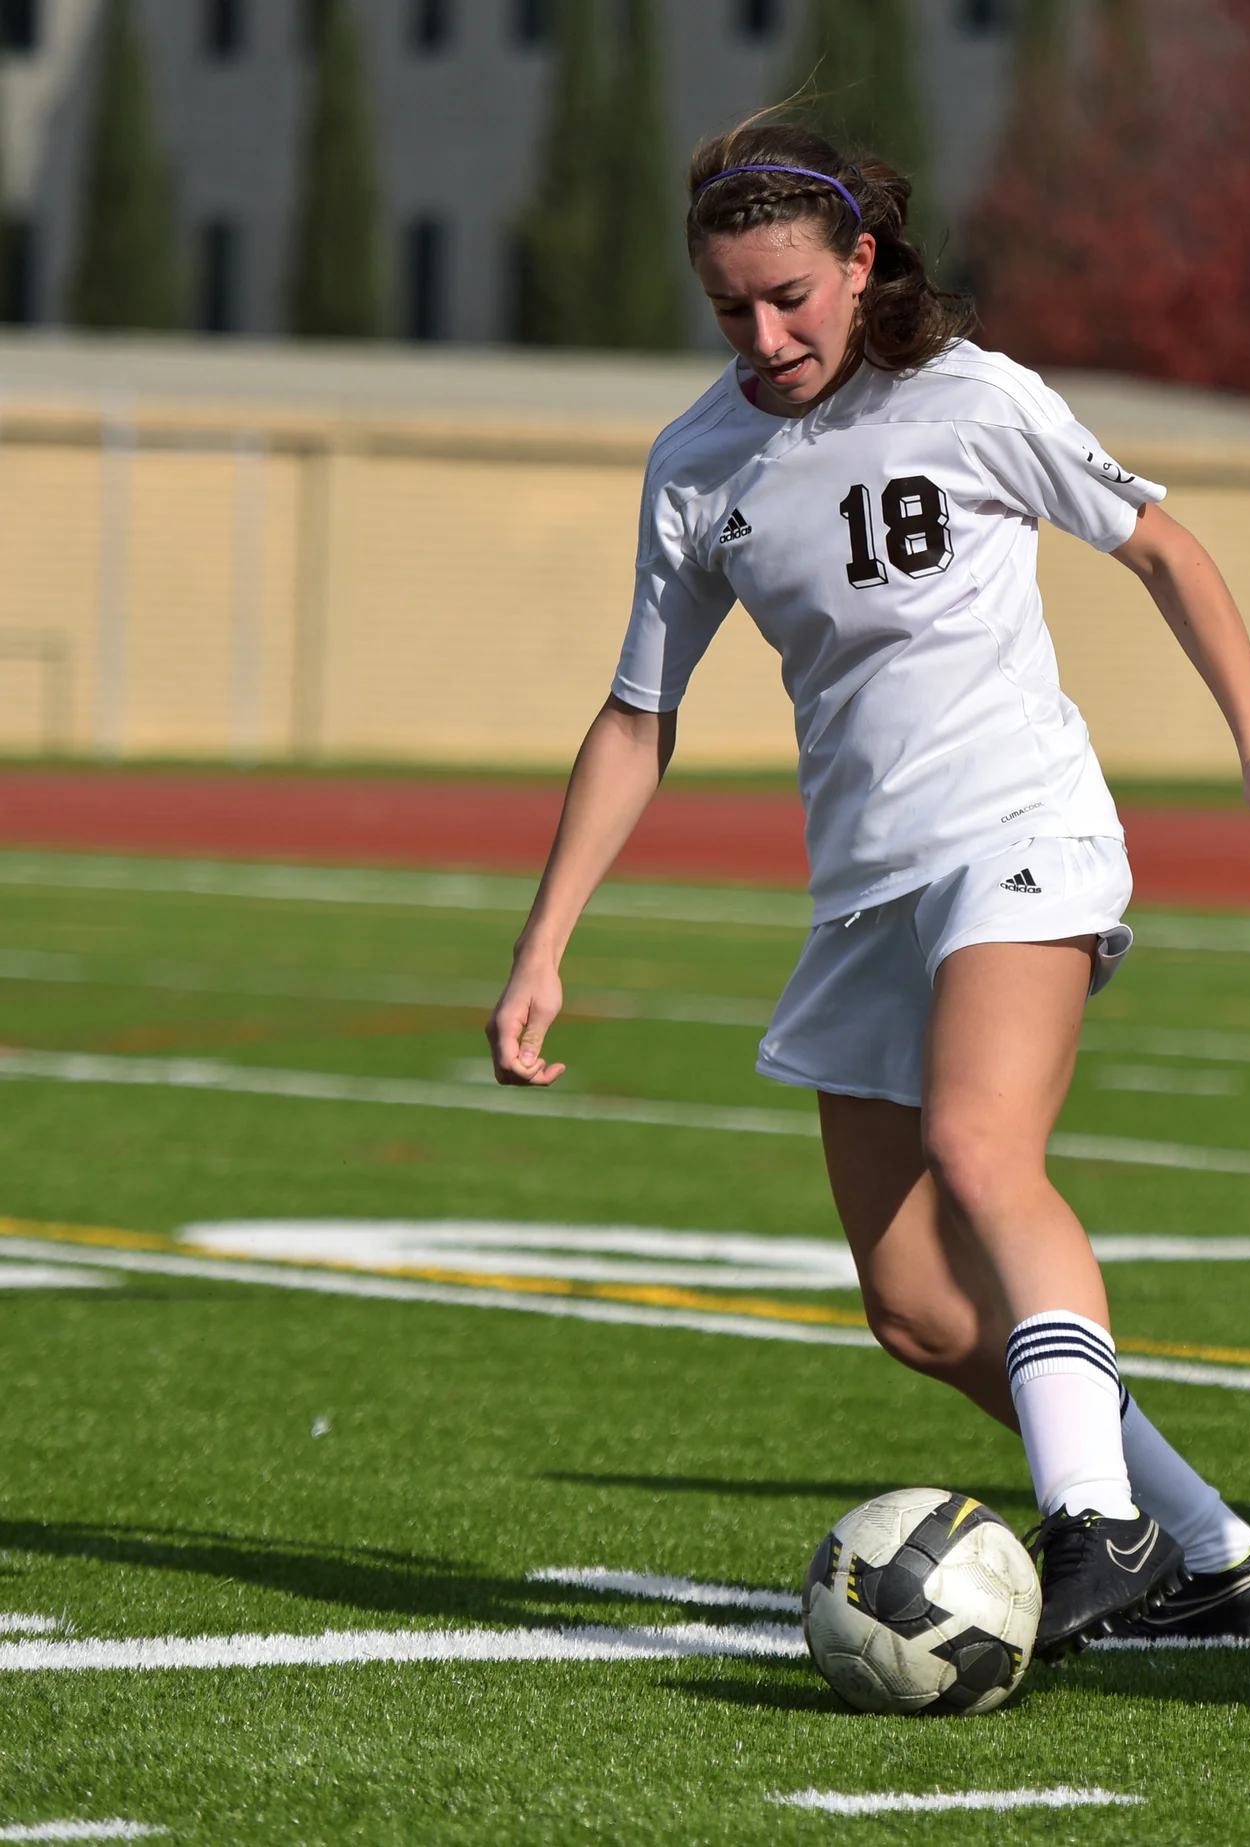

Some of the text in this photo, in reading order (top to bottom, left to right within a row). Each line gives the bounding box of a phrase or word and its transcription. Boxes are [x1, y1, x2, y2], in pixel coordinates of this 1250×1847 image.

[719, 525, 752, 544] adidas
[839, 474, 954, 589] 18
[1000, 880, 1042, 894] adidas
